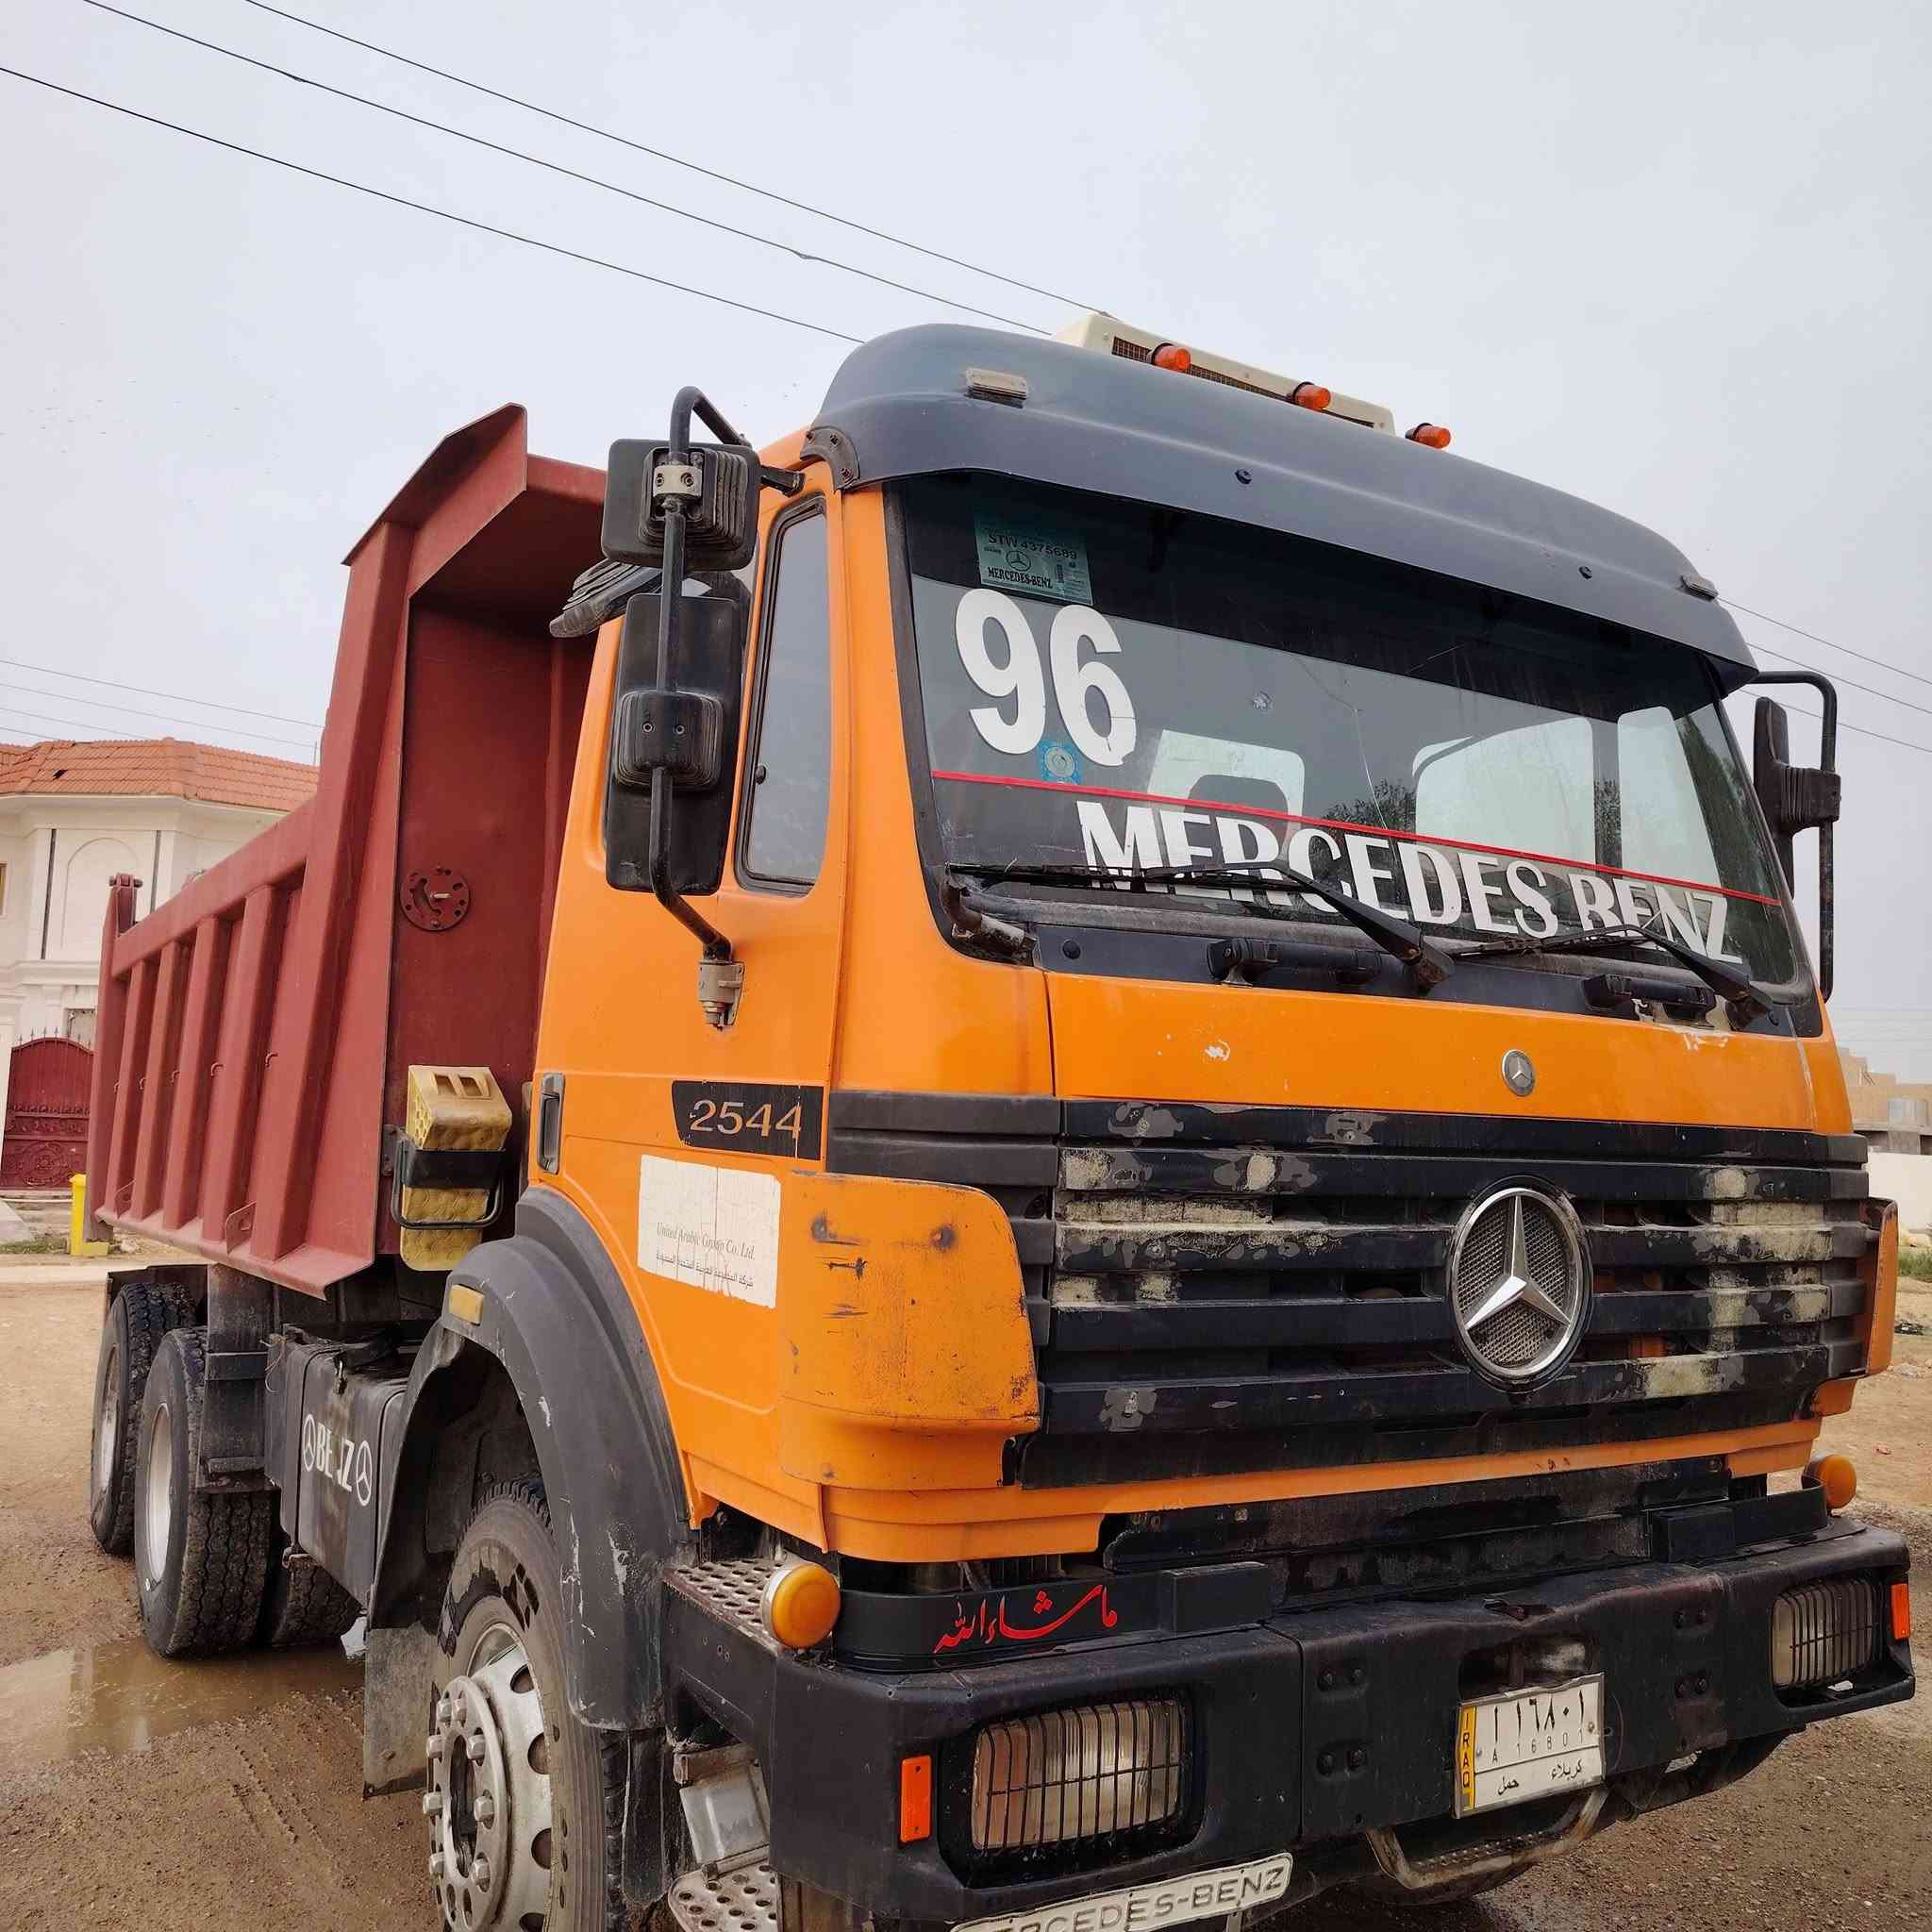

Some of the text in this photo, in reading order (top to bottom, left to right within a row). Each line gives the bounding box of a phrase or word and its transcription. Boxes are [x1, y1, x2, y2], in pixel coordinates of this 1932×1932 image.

[987, 566, 1054, 590] MERCEDES-BENZ
[955, 588, 1137, 766] 96
[1076, 800, 1743, 964] MERCEDES BENZ
[690, 1099, 801, 1140] 2544
[1462, 1712, 1471, 1789] IRAQ
[1491, 1727, 1584, 1763] A 16801
[1497, 1757, 1583, 1796] كربلاء حمل
[994, 1866, 1285, 1932] CEDES-BENZ
